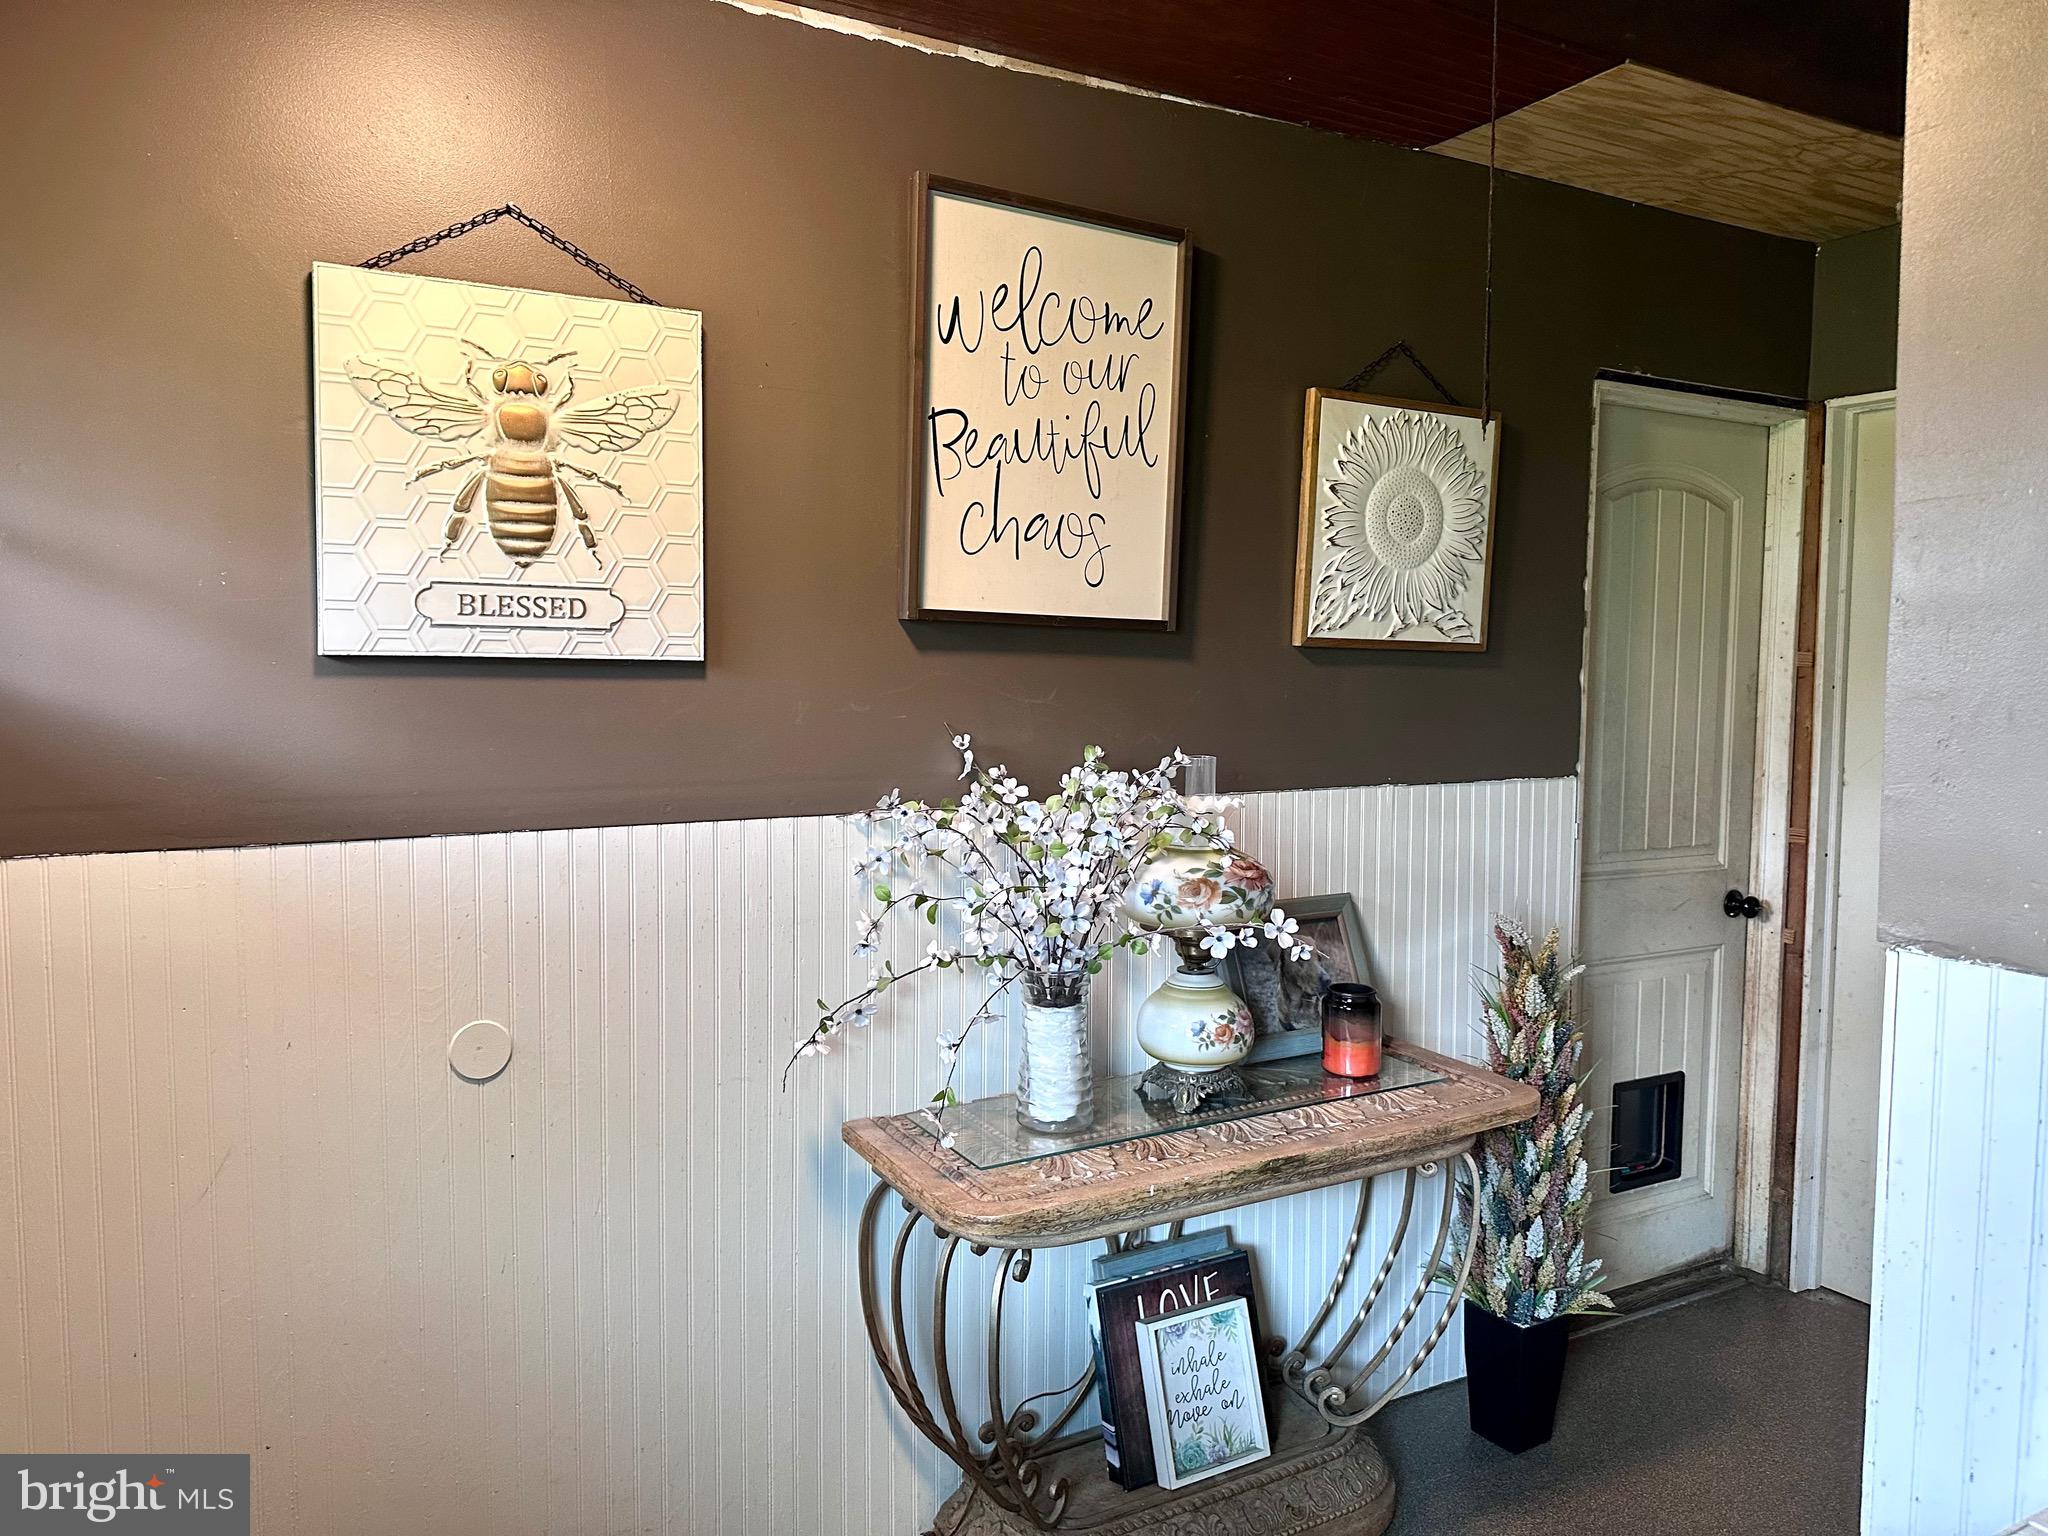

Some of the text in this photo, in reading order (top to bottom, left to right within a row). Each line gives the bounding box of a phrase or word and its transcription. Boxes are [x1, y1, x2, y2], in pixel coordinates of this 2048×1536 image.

[1000, 341, 1140, 406] to our
[927, 382, 1159, 500] Beautiful
[960, 458, 1111, 588] chaos
[457, 593, 587, 620] BLESSED
[1171, 1339, 1228, 1376] inhale
[1174, 1367, 1232, 1404] exhale
[1221, 1388, 1246, 1410] on
